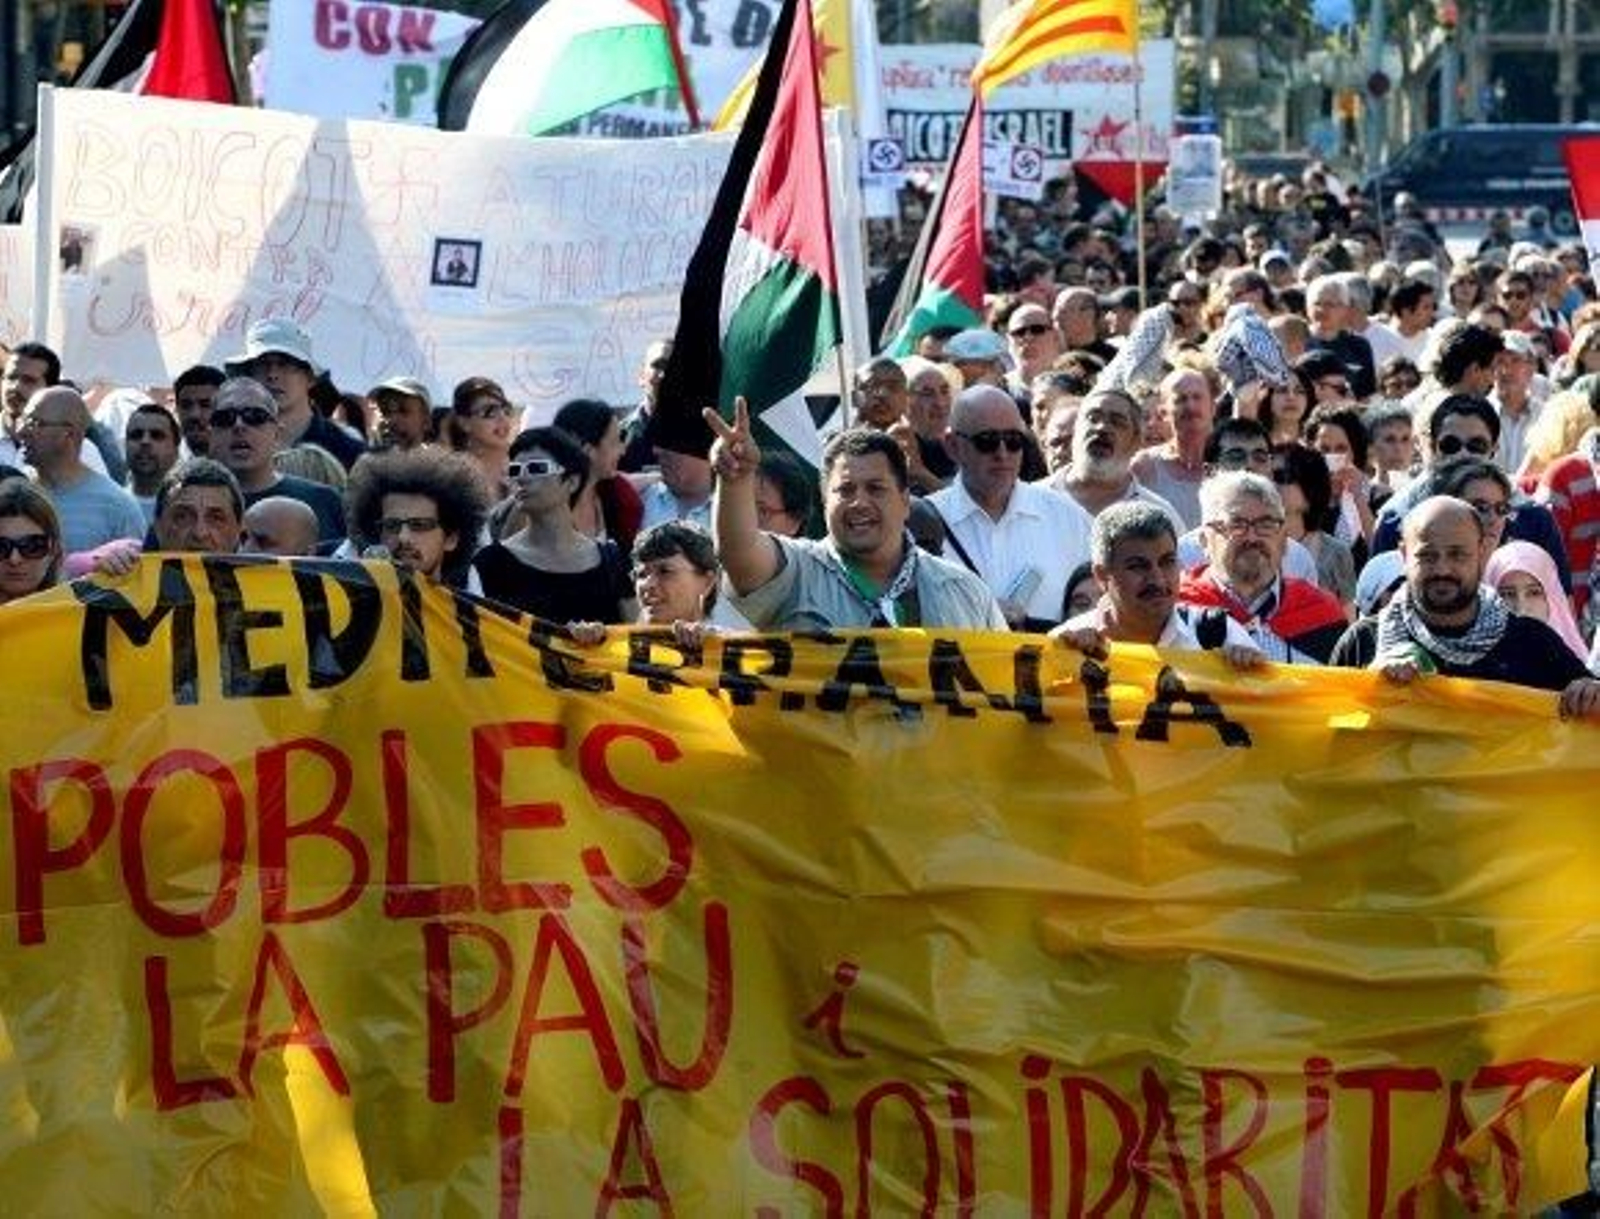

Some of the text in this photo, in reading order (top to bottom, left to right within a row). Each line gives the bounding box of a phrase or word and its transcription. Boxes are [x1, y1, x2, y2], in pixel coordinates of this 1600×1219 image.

[66, 119, 373, 252] BOICOT
[8, 721, 694, 946] POBLES
[144, 930, 351, 1111] LA
[424, 902, 734, 1102] PAU
